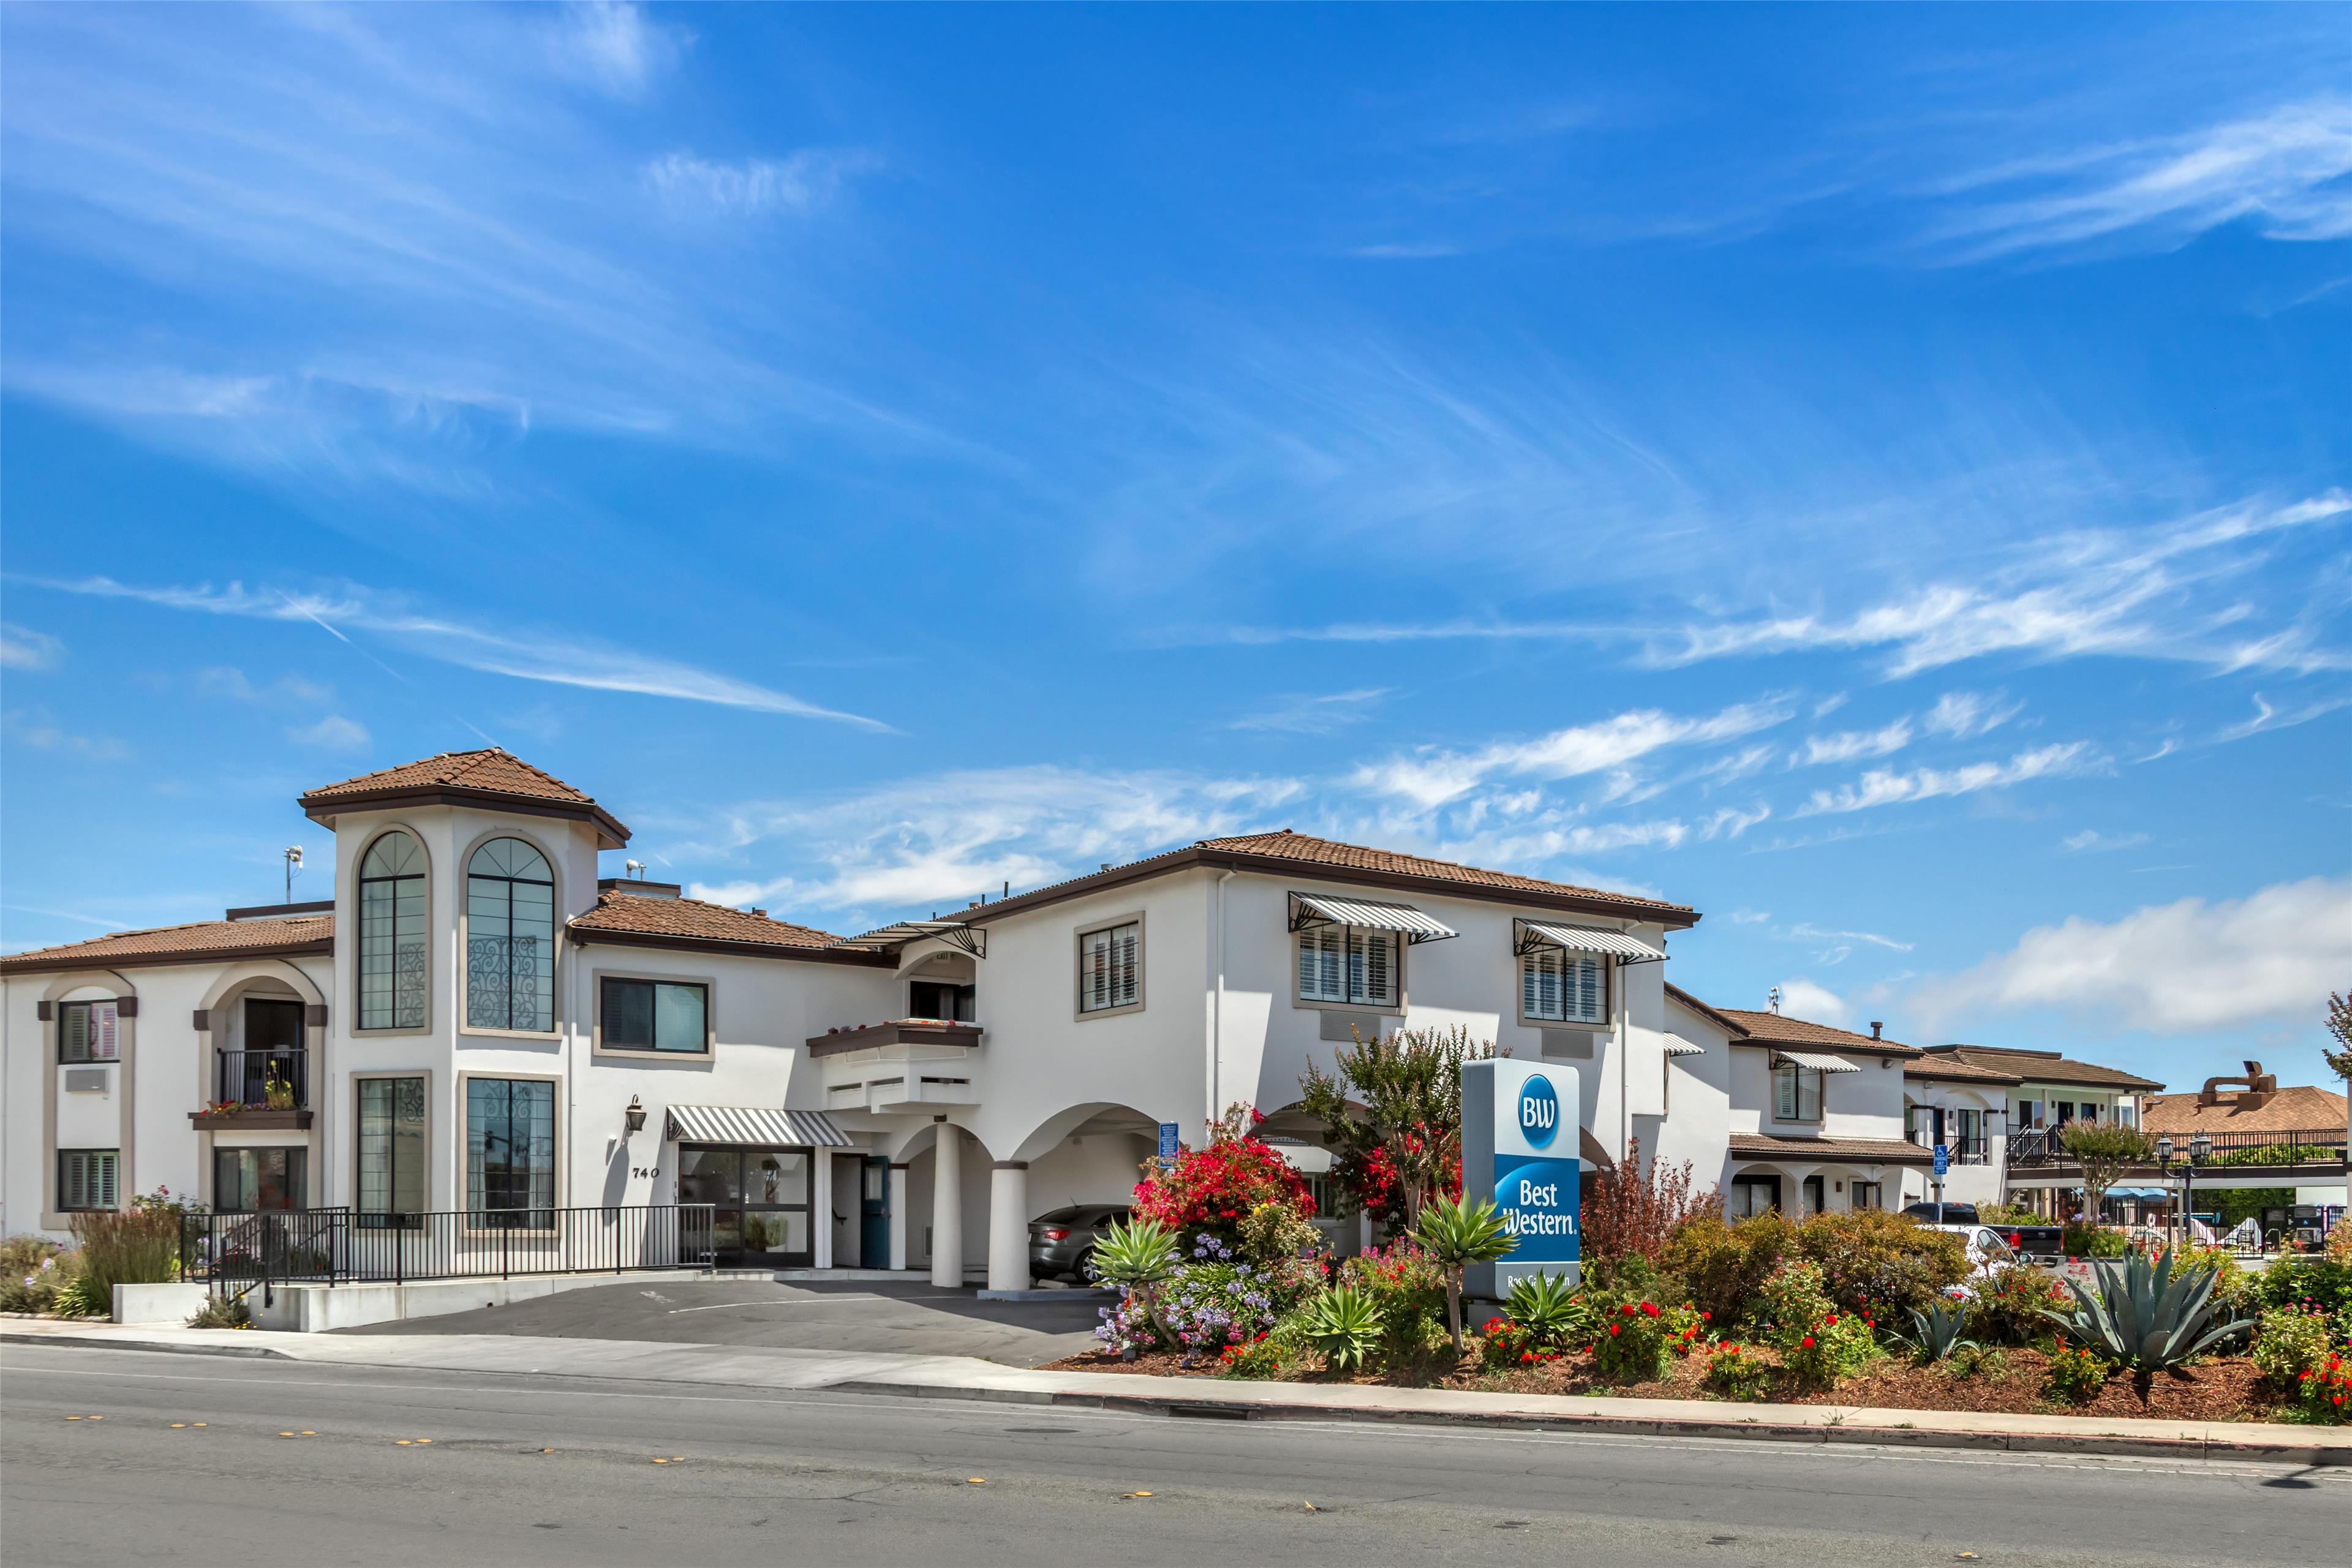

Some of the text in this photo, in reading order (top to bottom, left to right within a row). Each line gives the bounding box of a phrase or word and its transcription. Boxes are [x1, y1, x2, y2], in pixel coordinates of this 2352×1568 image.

[1523, 1097, 1555, 1128] BW
[632, 1167, 659, 1179] 740
[1520, 1180, 1558, 1207] Best
[1503, 1208, 1573, 1235] Western
[1508, 1275, 1524, 1287] Ros
